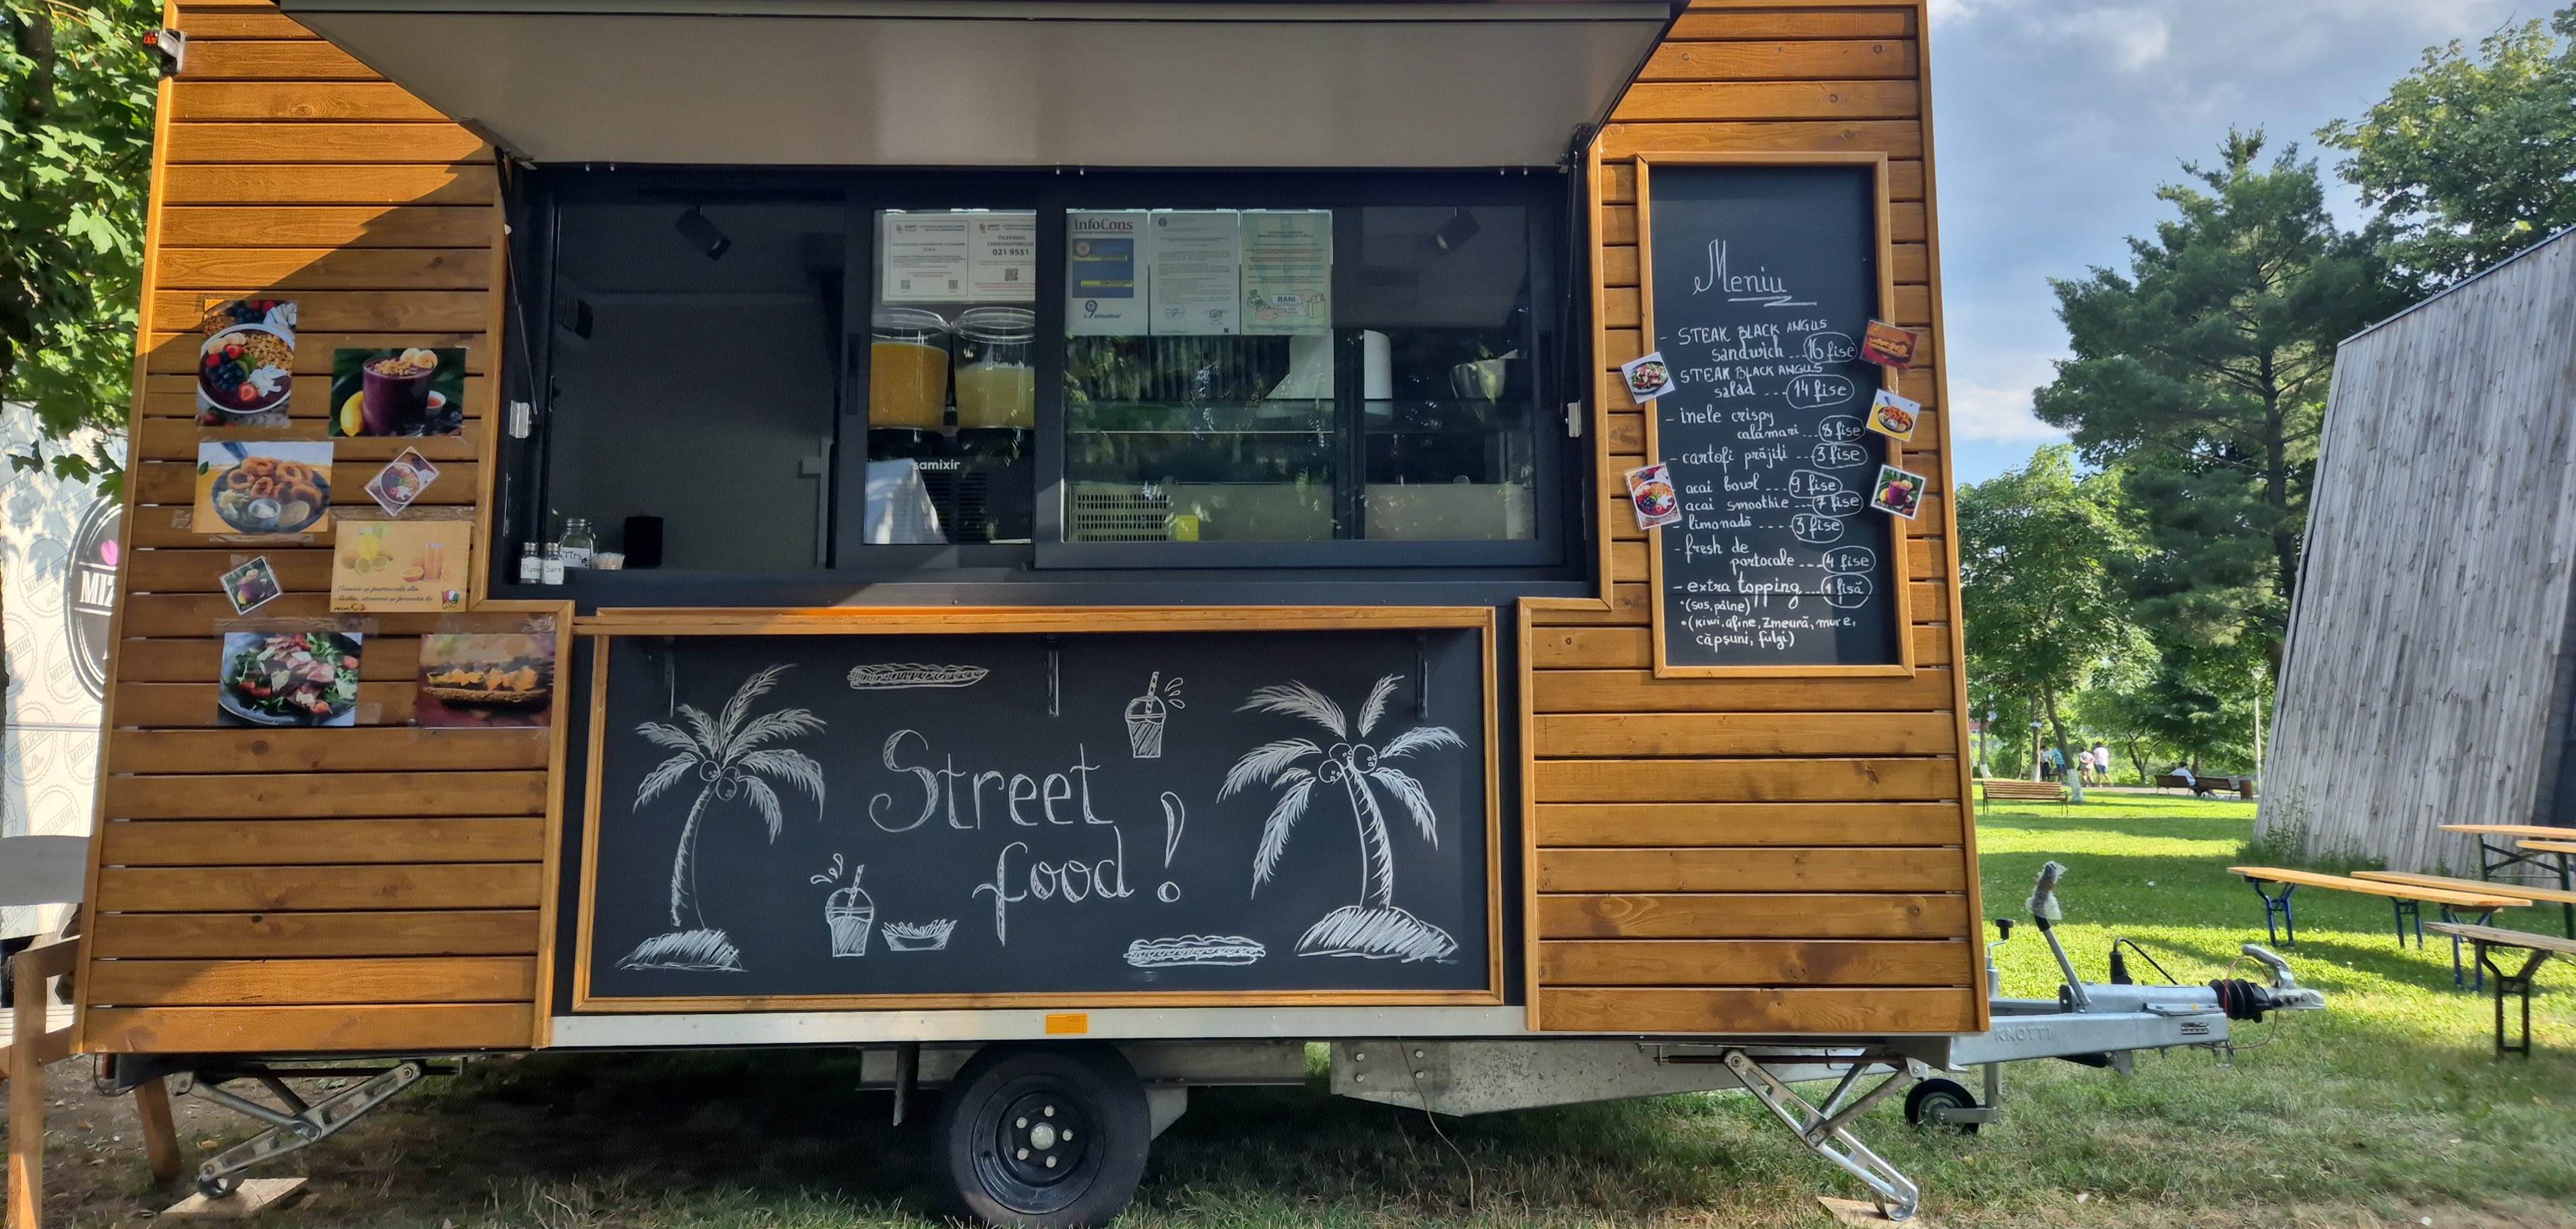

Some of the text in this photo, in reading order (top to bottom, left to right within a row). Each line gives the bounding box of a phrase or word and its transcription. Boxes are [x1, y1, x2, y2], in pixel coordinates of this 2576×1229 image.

[1074, 218, 1133, 230] InfoCons
[1692, 239, 1787, 296] Meniu
[1678, 319, 1828, 346] STEAK BLACK ANGUS
[1711, 335, 1785, 363] sandwich
[1807, 338, 1824, 360] 16
[1680, 364, 1823, 383] STEAK BLACK ANGUS
[1714, 379, 1756, 398] salad
[1793, 379, 1808, 398] 14
[1680, 404, 1774, 431] inele crispy
[1737, 424, 1800, 439] calamari
[1822, 423, 1833, 437] 8
[1682, 443, 1735, 474] cartofi
[1816, 446, 1826, 462] 3
[1686, 480, 1713, 494] acai
[1723, 472, 1759, 491] bowl
[1790, 476, 1801, 493] 9
[1685, 497, 1715, 511] acai
[1726, 494, 1789, 511] smoothie
[1816, 497, 1827, 509] 7
[1688, 512, 1752, 530] limonadă
[1795, 517, 1805, 534] 3
[1684, 533, 1750, 564] fresh de
[546, 565, 563, 573] Sare
[1729, 548, 1795, 575] portocale
[1826, 554, 1834, 568] 4
[1687, 579, 1731, 592] extra
[1737, 571, 1800, 610] topping
[1824, 583, 1831, 594] 1
[868, 728, 1114, 833] Street
[1994, 1026, 2045, 1042] KNOTT
